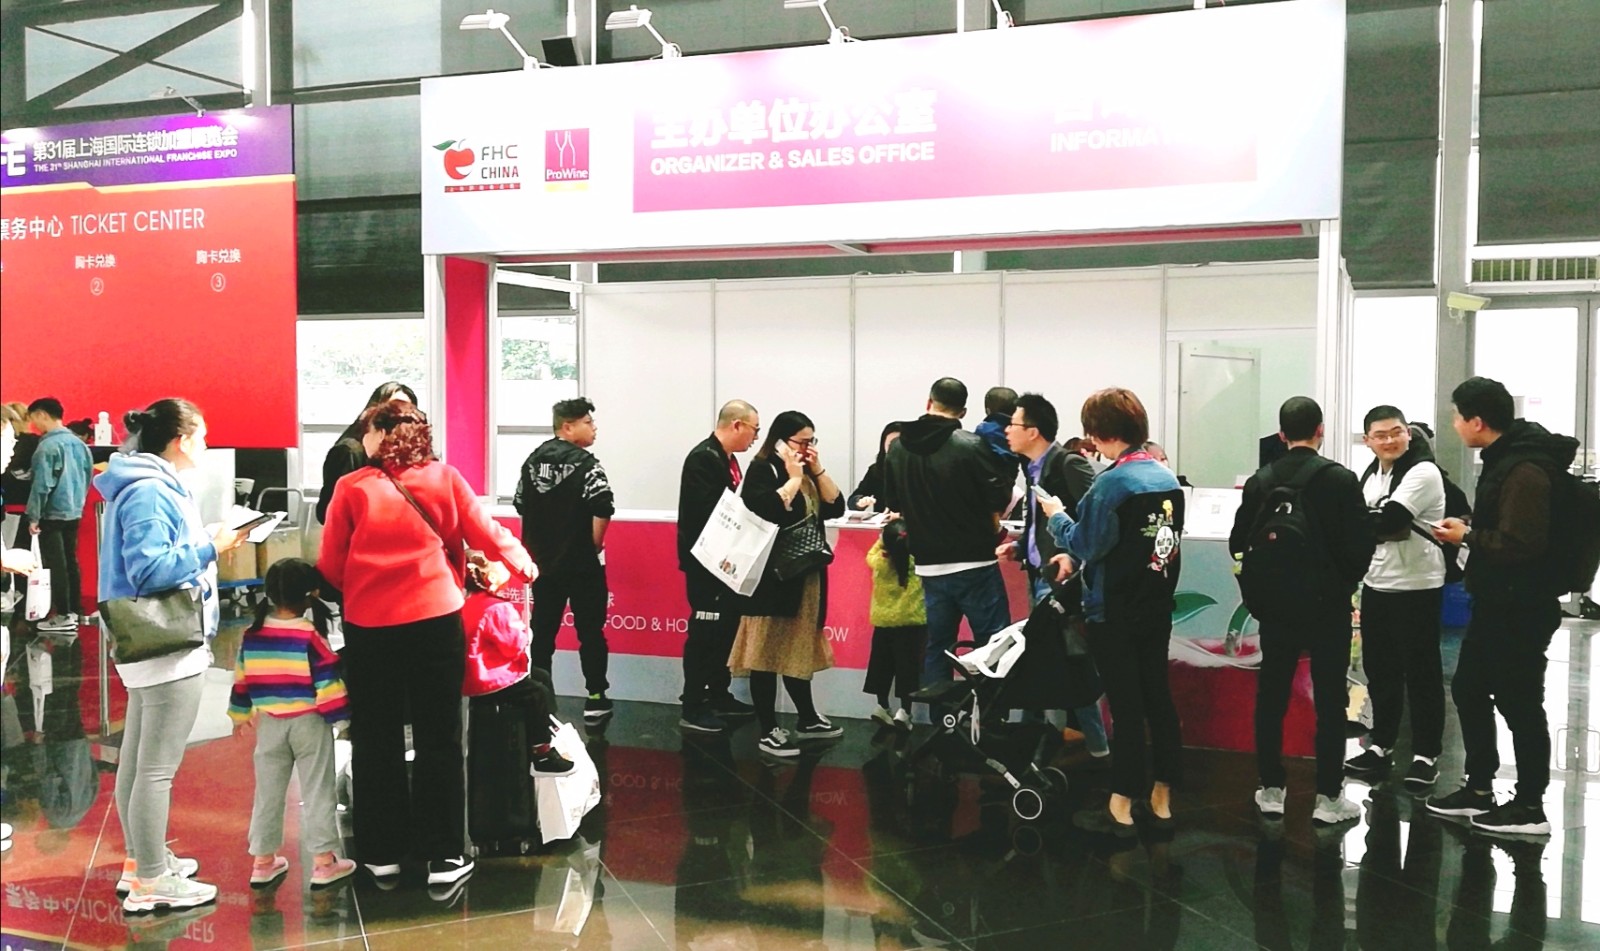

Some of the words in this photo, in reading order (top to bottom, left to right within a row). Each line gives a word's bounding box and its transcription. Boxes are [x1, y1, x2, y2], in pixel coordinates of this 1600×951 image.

[33, 125, 239, 161] 第31届上海国际连锁加览会
[481, 144, 518, 160] FHC
[34, 163, 49, 172] THE
[63, 159, 102, 170] SHANGHAI
[103, 154, 166, 167] INTERNATIONAL
[166, 150, 213, 162] FRANCHISE
[214, 148, 238, 159] EXPO
[651, 152, 765, 176] ORGANIZER
[768, 150, 784, 169] &
[788, 146, 855, 168] SALES
[858, 141, 936, 164] OFFICE
[481, 165, 519, 179] CHINA
[546, 168, 589, 181] ProWine
[71, 213, 128, 235] TICKET
[133, 208, 206, 232] CENTER
[651, 616, 662, 631] &
